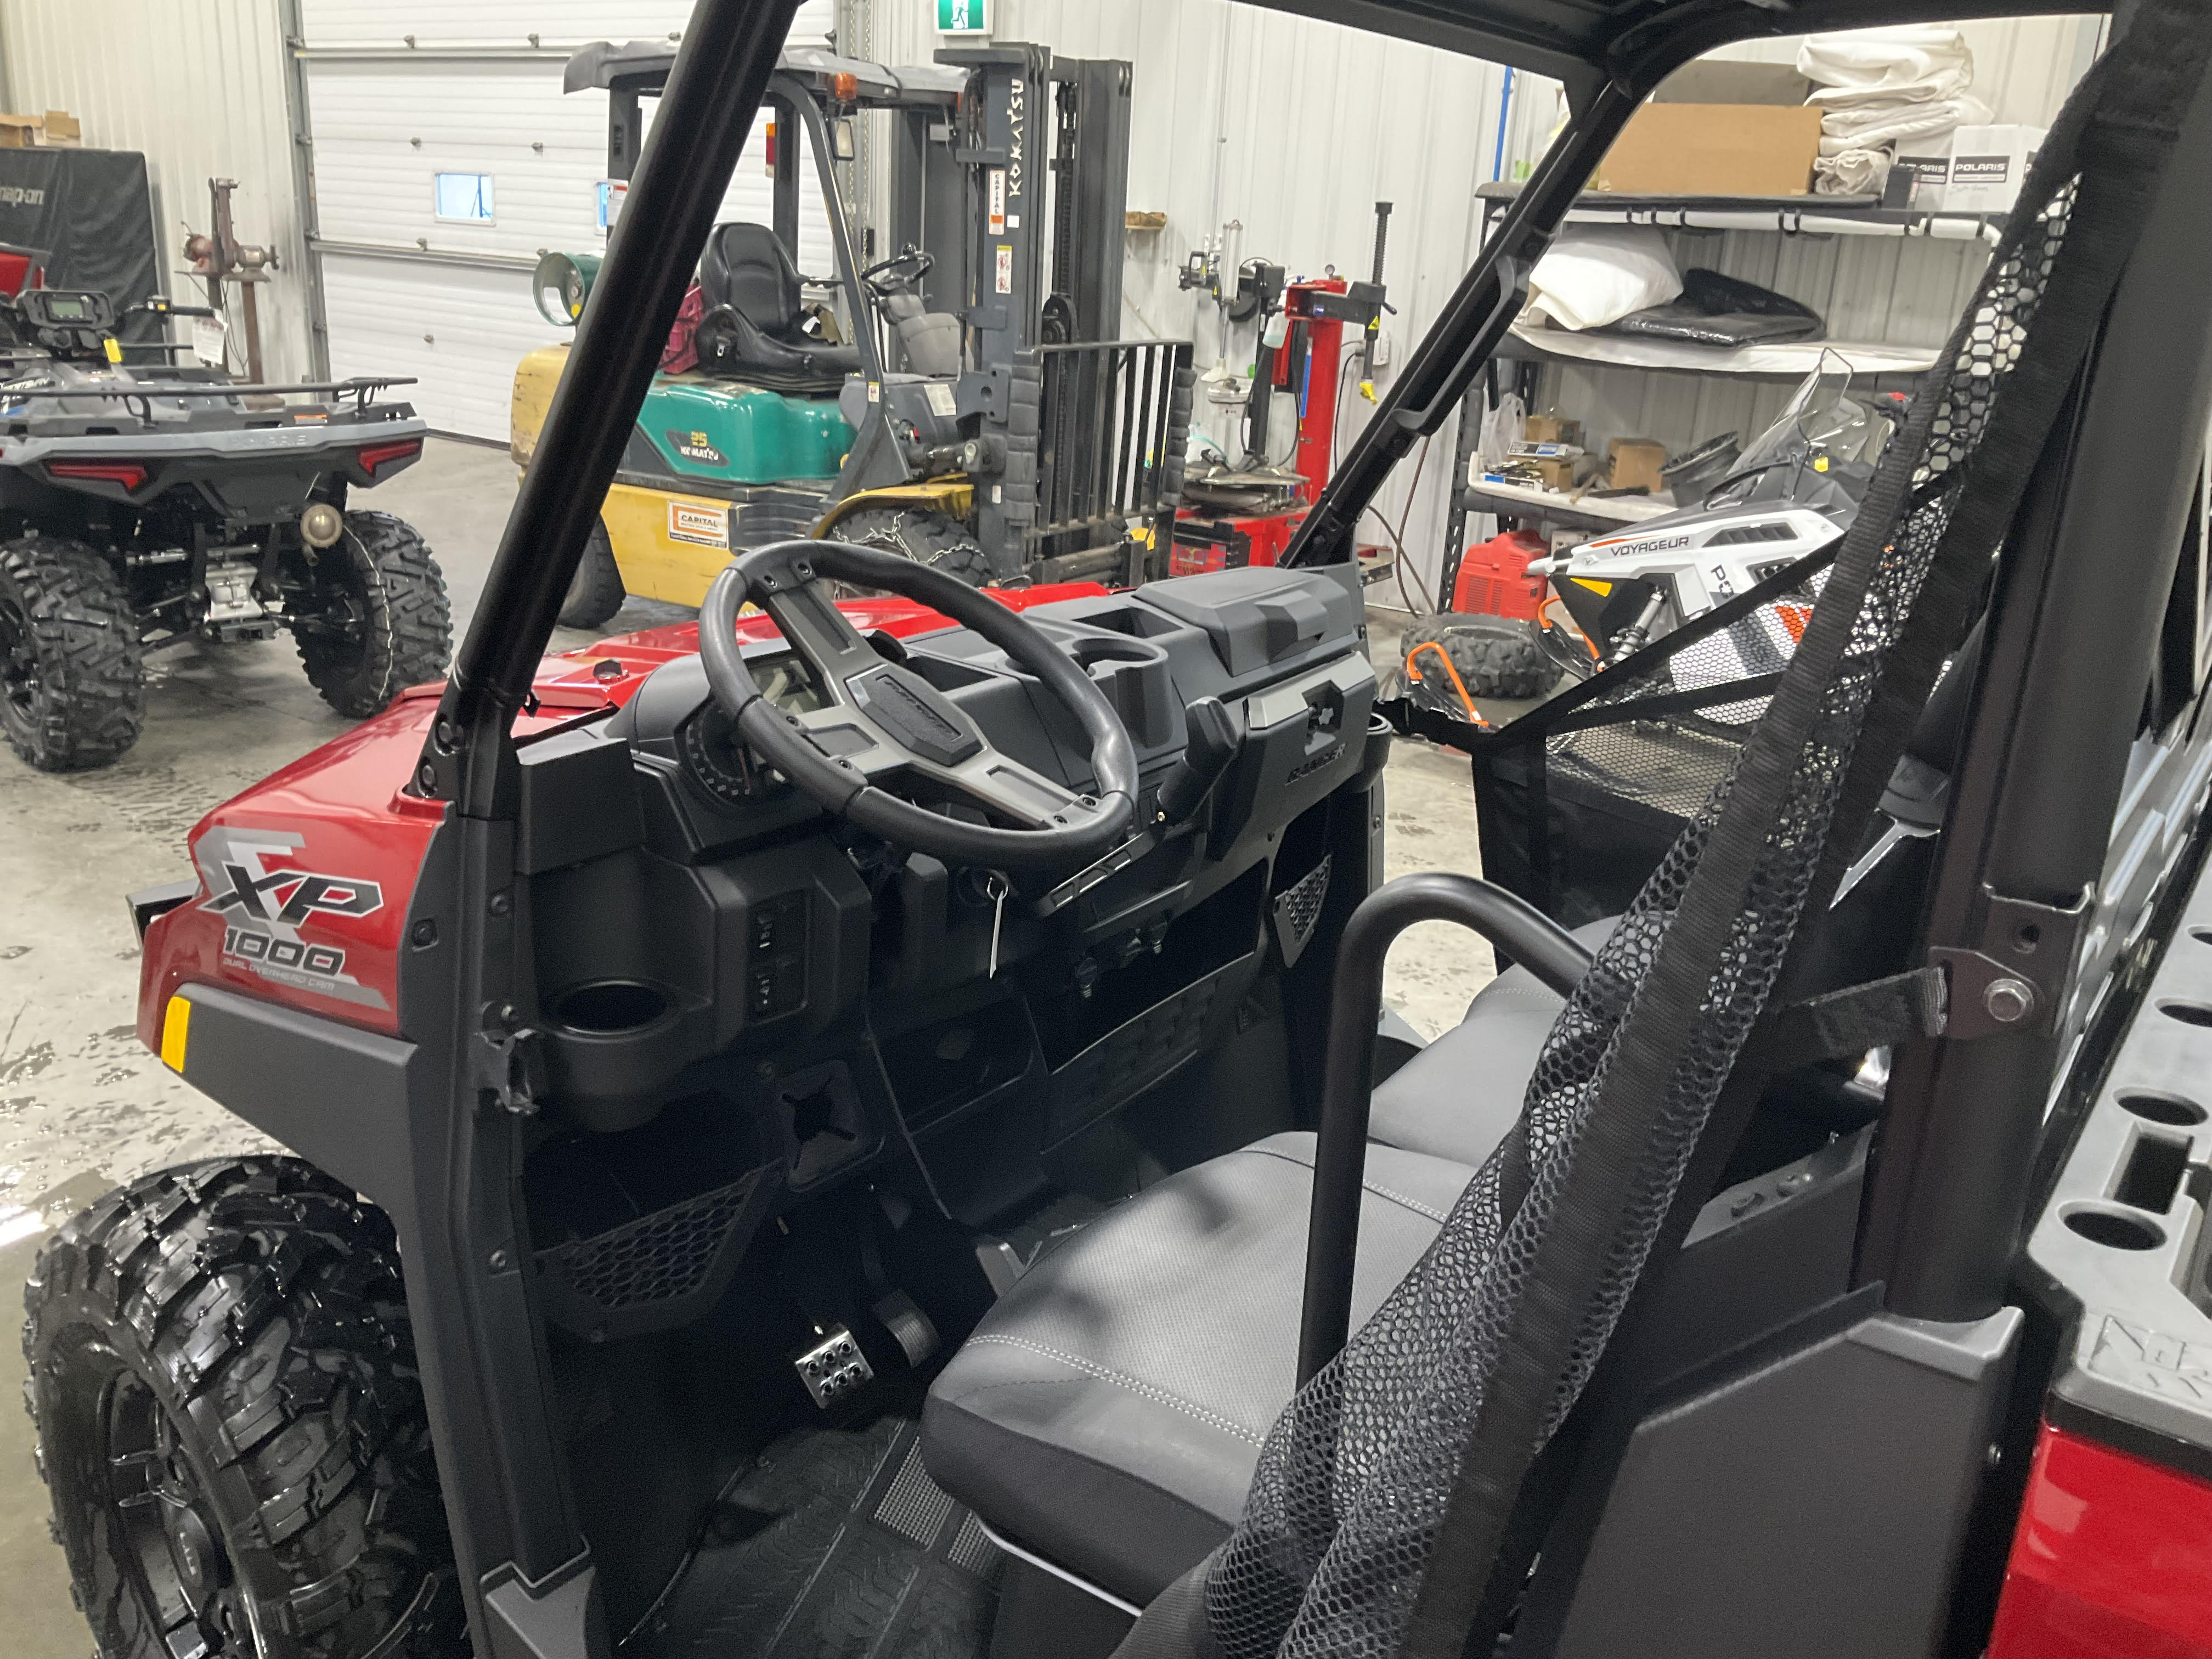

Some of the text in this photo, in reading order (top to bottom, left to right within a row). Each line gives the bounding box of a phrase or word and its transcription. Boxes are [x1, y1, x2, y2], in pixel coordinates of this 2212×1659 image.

[1007, 78, 1024, 197] KOMATSU
[1955, 163, 2006, 171] POLARIS
[691, 431, 708, 447] 25
[680, 445, 719, 461] KOMATSU
[681, 515, 718, 527] CAPITAL
[1611, 536, 1689, 556] VOYAGEUR
[197, 862, 383, 927] XP
[223, 926, 346, 977] 1000
[223, 957, 335, 991] DUAL OVERHEAD CAM
